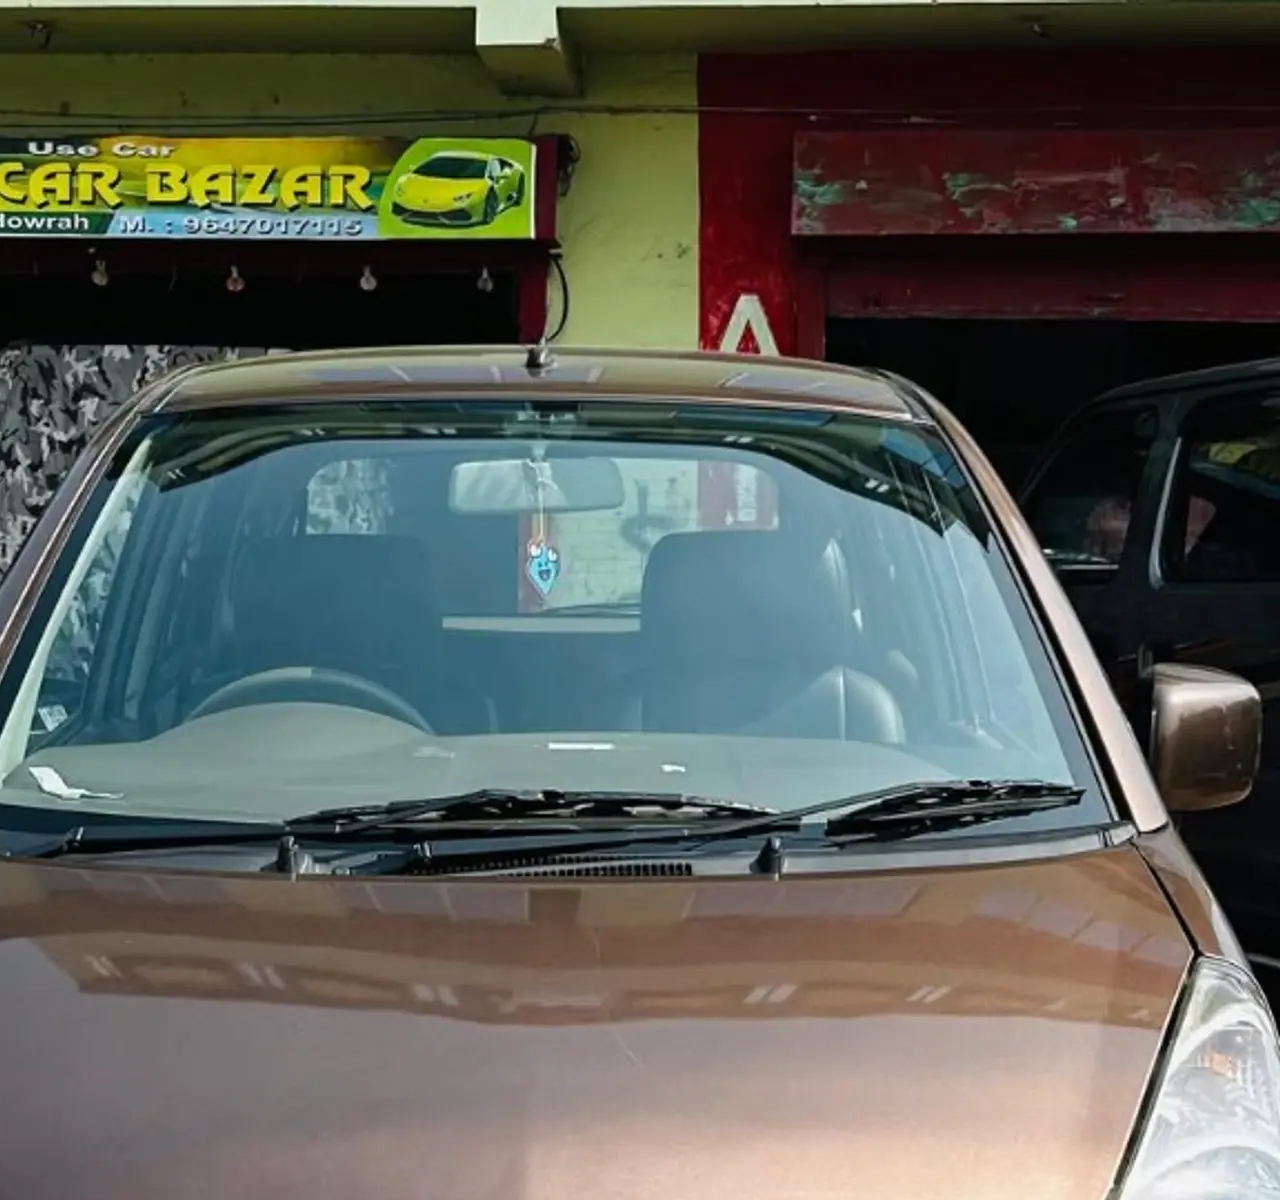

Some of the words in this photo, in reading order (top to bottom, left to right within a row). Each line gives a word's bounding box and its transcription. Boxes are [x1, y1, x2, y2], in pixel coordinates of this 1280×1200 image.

[28, 141, 100, 157] Use
[111, 142, 176, 158] Car
[145, 162, 378, 213] BAZAR
